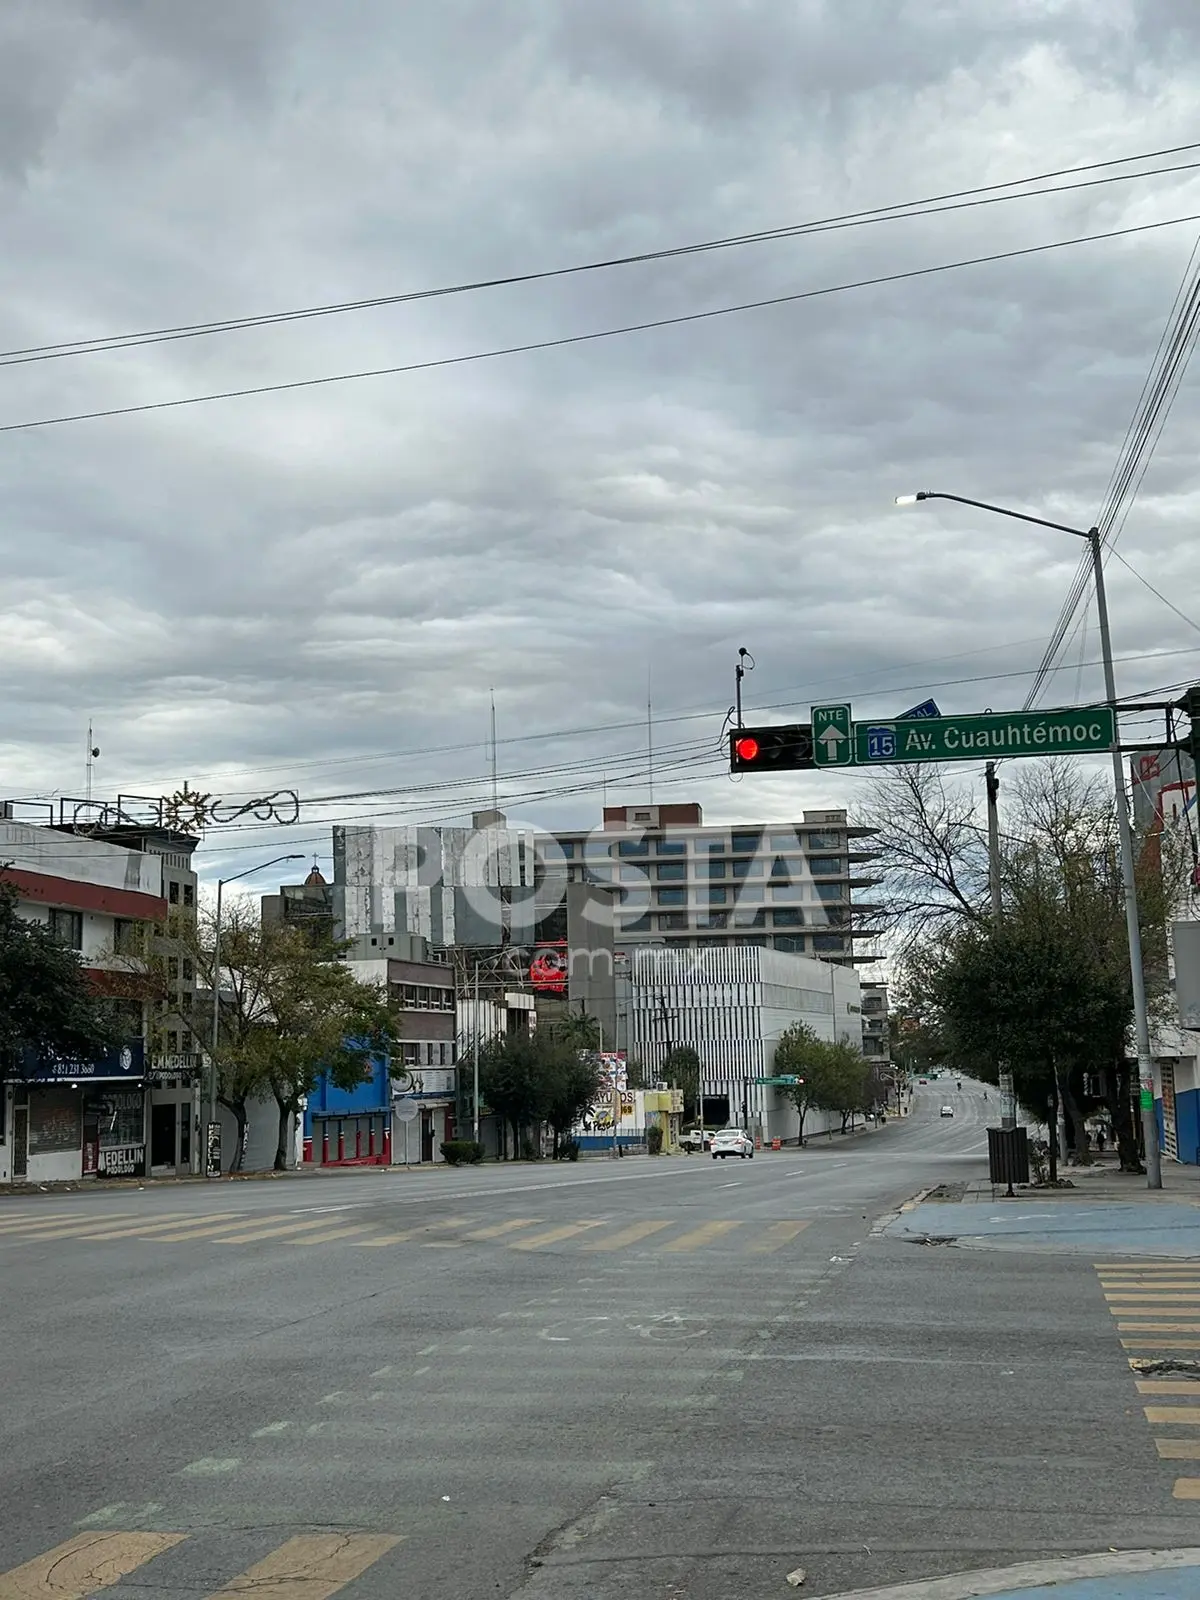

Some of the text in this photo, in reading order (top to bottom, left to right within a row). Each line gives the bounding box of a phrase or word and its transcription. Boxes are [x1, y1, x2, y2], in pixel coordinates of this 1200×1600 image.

[818, 709, 844, 722] NTE
[870, 736, 893, 756] 15
[905, 721, 1101, 751] Av. Cuauhtémoc
[98, 1148, 144, 1171] MEDELLIN
